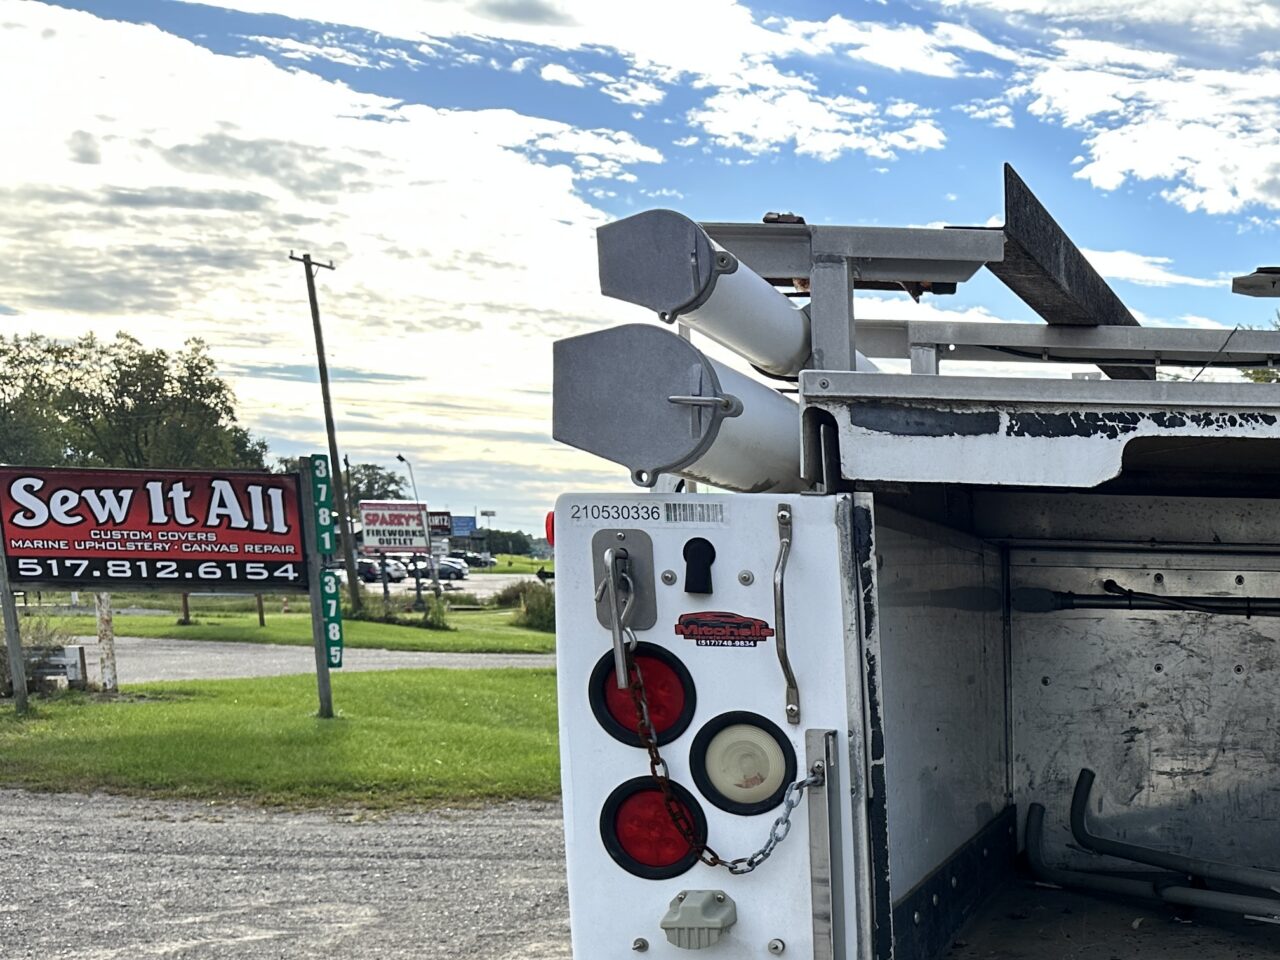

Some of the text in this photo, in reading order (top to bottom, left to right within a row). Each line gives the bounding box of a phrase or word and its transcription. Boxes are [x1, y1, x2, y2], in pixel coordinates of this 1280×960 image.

[10, 477, 289, 534] Sew It All
[314, 459, 332, 550] 3781
[570, 504, 661, 520] 210530336
[364, 512, 424, 527] SPARKY'S
[90, 530, 217, 541] CUSTOM COVERS
[366, 529, 426, 538] FIREWORKS
[11, 539, 295, 554] MARINE UPHOLSTERY CANVAS REPAIR
[378, 537, 414, 546] OUTLET
[18, 558, 299, 580] 517.812.6154
[323, 575, 341, 664] 3785
